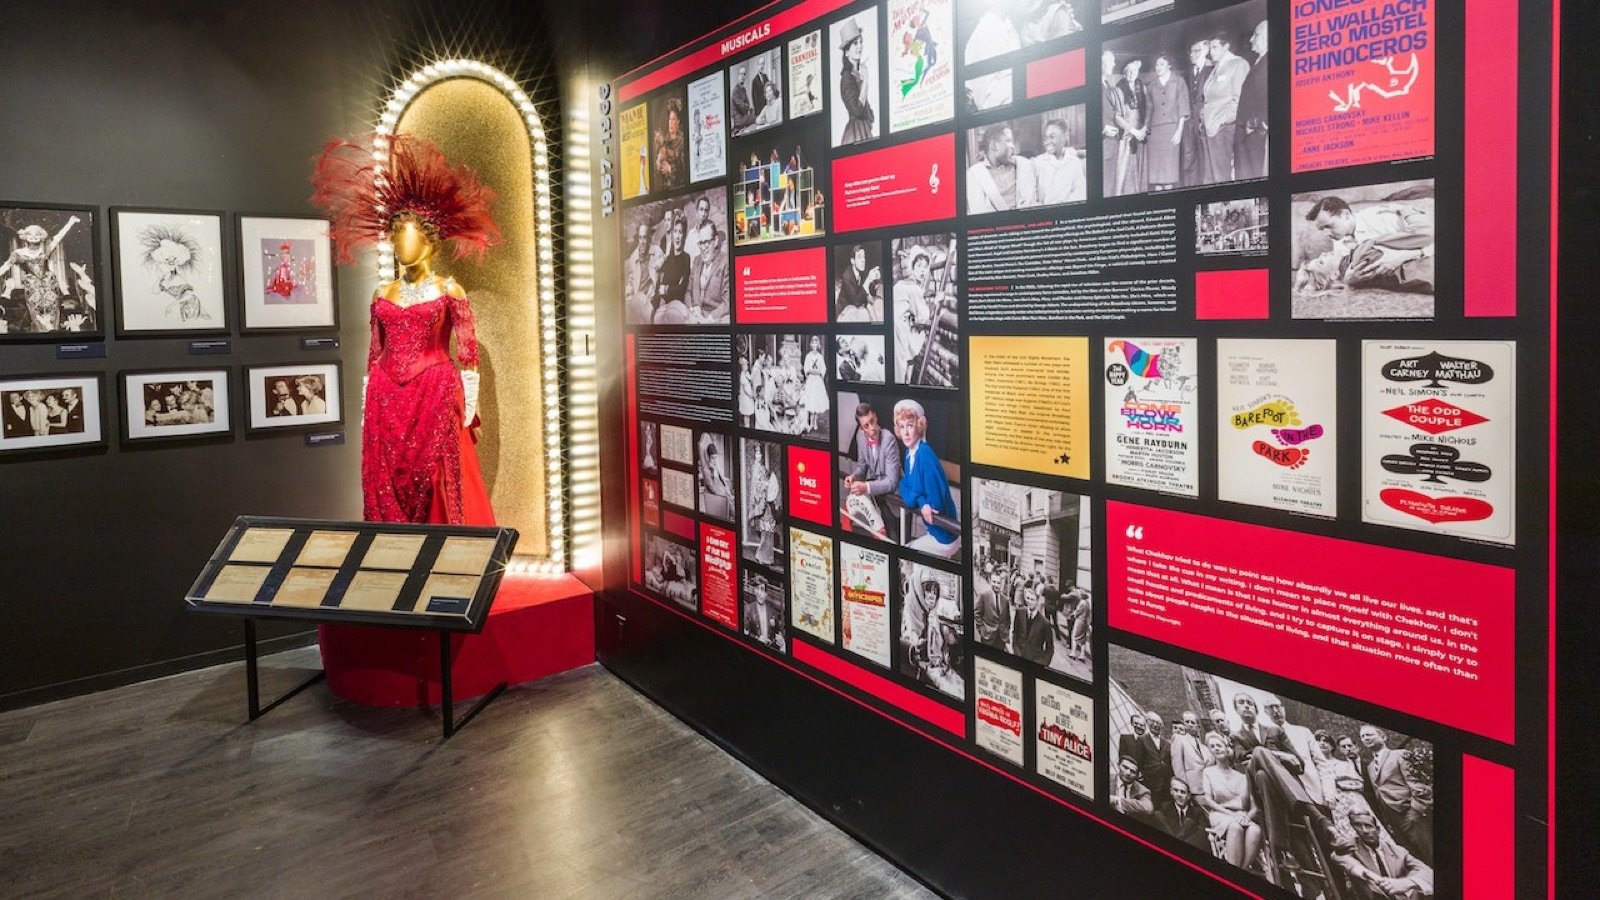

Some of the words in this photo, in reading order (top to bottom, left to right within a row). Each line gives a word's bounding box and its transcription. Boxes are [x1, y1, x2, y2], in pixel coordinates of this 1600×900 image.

[1295, 22, 1321, 40] ELI
[1328, 0, 1427, 31] WALLACH
[721, 23, 771, 55] MUSICALS
[1295, 32, 1342, 55] ZERO
[1349, 13, 1427, 42] MOSTEL
[1295, 30, 1427, 75] RHINOCEROS
[1322, 69, 1355, 81] ANTHONY
[1296, 116, 1321, 127] MORRIS
[1324, 110, 1366, 123] CARNOVSKY
[1296, 126, 1325, 136] MICHAEL
[1327, 121, 1355, 131] STRONG
[1363, 116, 1380, 125] MIKE
[1383, 111, 1410, 122] KELLIN
[1303, 142, 1320, 154] ANNE
[1323, 140, 1354, 151] JACKSON
[1400, 360, 1419, 368] ART
[1440, 361, 1478, 370] WALTER
[1390, 368, 1429, 378] CARNEY
[1435, 369, 1481, 379] MATTHAU
[1385, 388, 1405, 396] NEIL
[1408, 388, 1447, 397] SIMON'S
[1121, 408, 1176, 419] BLOW
[1124, 401, 1181, 413] COME
[1407, 405, 1430, 415] THE
[1432, 407, 1461, 416] ODD
[1126, 414, 1180, 425] YOUR
[1235, 408, 1286, 427] BAREFOOT
[1409, 415, 1462, 426] COUPLE
[1127, 420, 1183, 432] HORN
[1284, 432, 1294, 441] IN
[1297, 428, 1316, 439] THE
[1411, 434, 1435, 442] MIKE
[1438, 436, 1477, 445] NICHOLS
[1116, 435, 1140, 445] GENE
[1144, 438, 1187, 450] RAYBURN
[1260, 443, 1290, 462] PARK
[1145, 462, 1186, 472] CARNOVSKY
[1168, 482, 1193, 490] THEATRE
[1201, 561, 1212, 570] do
[1213, 564, 1228, 573] was
[1229, 567, 1238, 575] to
[1239, 569, 1259, 581] point
[1260, 574, 1275, 584] out
[1276, 576, 1294, 587] how
[1296, 581, 1333, 595] absurdly
[1334, 589, 1347, 598] we
[1350, 593, 1360, 601] all
[1363, 595, 1379, 605] live
[1381, 600, 1397, 609] our
[1426, 609, 1446, 620] and
[1448, 613, 1478, 626] that's
[1168, 565, 1180, 573] the
[1196, 570, 1204, 578] in
[1205, 573, 1217, 582] my
[1253, 583, 1275, 594] don't
[1276, 589, 1300, 600] mean
[1302, 594, 1311, 602] to
[1313, 597, 1336, 609] place
[1339, 602, 1369, 615] myself
[1371, 610, 1393, 621] with
[1394, 614, 1440, 632] Chekhov.
[1450, 627, 1478, 640] don't
[1181, 578, 1200, 588] What
[1205, 584, 1226, 594] mean
[1227, 588, 1234, 596] is
[1235, 589, 1251, 600] that
[1257, 596, 1270, 604] see
[1271, 599, 1299, 611] humor
[1301, 605, 1310, 614] in
[1311, 608, 1340, 621] almost
[1342, 616, 1390, 634] everything
[1392, 628, 1428, 642] around
[1447, 639, 1457, 648] In
[1459, 643, 1478, 653] the
[1235, 601, 1244, 609] of
[1269, 609, 1285, 620] and
[1291, 615, 1304, 625] try
[1305, 618, 1315, 627] to
[1316, 621, 1350, 636] capture
[1352, 629, 1359, 638] it
[1361, 633, 1374, 641] on
[1412, 645, 1446, 660] simply
[1448, 653, 1464, 665] try
[1466, 657, 1478, 667] to
[1190, 602, 1215, 614] caught
[1216, 607, 1225, 615] in
[1226, 608, 1239, 620] the
[1240, 613, 1275, 628] situation
[1275, 622, 1285, 631] of
[1312, 633, 1329, 643] and
[1331, 637, 1349, 648] that
[1351, 642, 1392, 658] situation
[1395, 654, 1421, 666] more
[1423, 661, 1451, 674] often
[1453, 667, 1478, 681] than
[1042, 727, 1062, 746] TINY
[1063, 738, 1090, 758] ALICE
